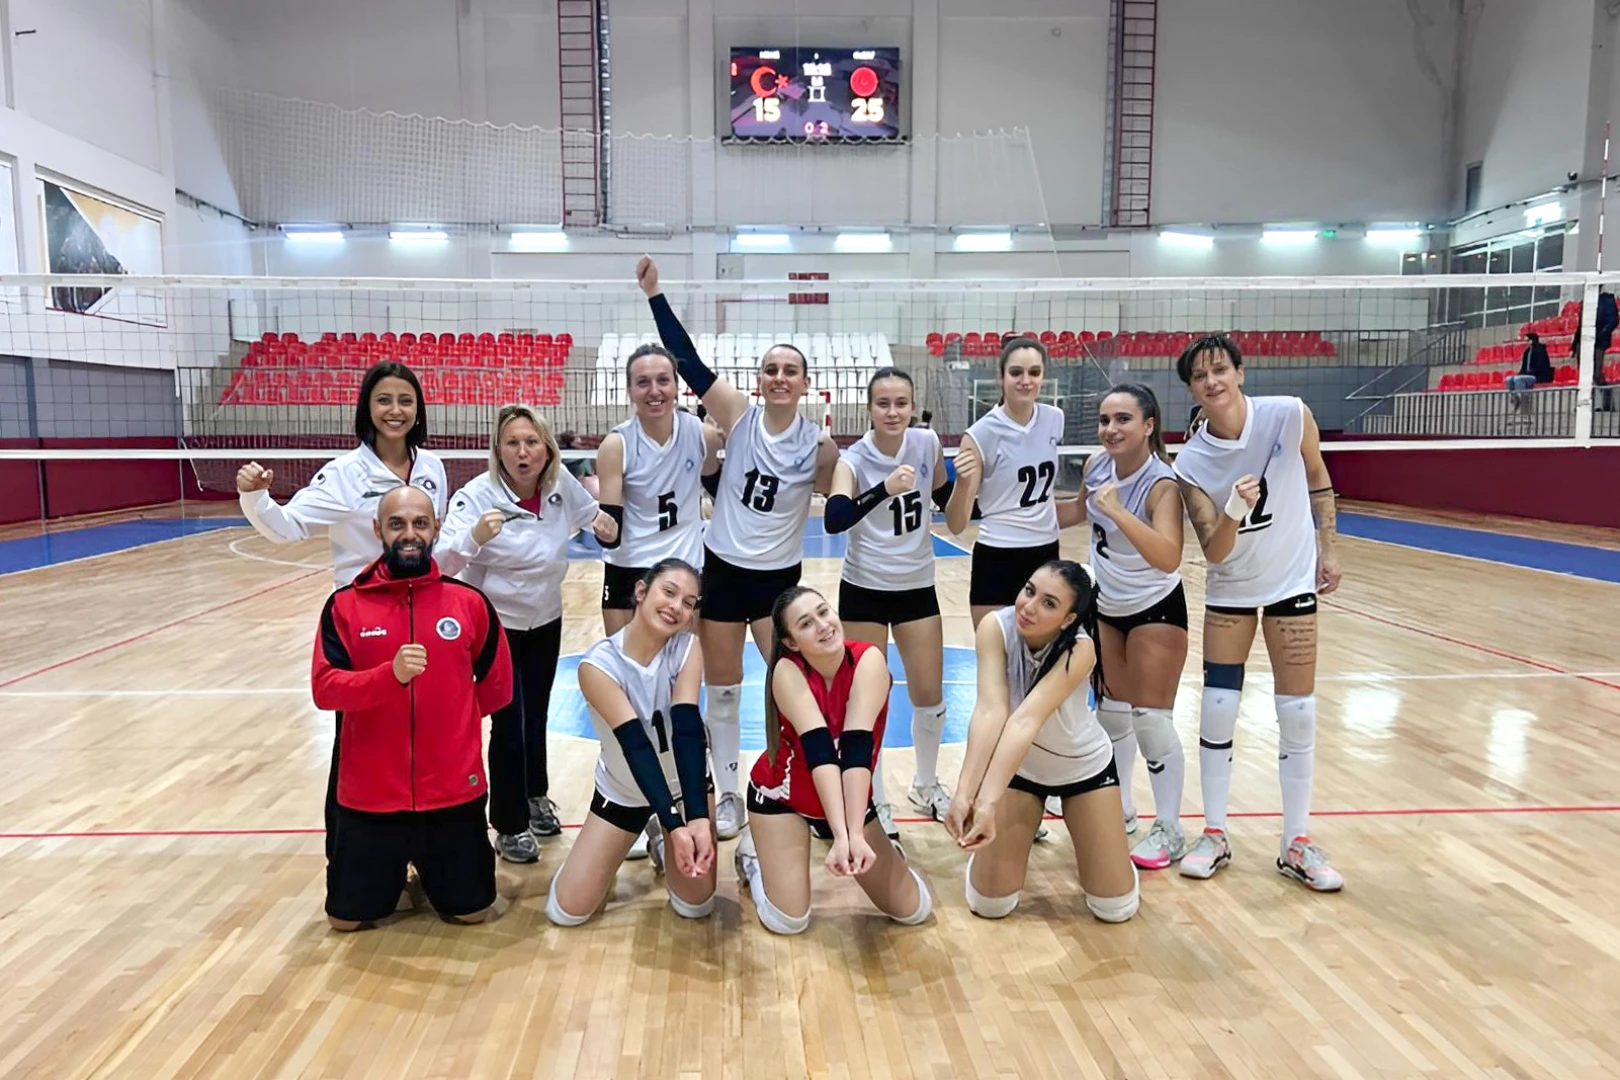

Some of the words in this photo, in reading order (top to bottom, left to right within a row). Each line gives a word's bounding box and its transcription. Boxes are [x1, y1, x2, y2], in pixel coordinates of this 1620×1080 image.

[753, 98, 781, 122] 15
[851, 98, 884, 122] 25
[741, 466, 779, 513] 13
[1018, 460, 1055, 507] 22
[658, 491, 678, 532] 5
[889, 491, 922, 536] 15
